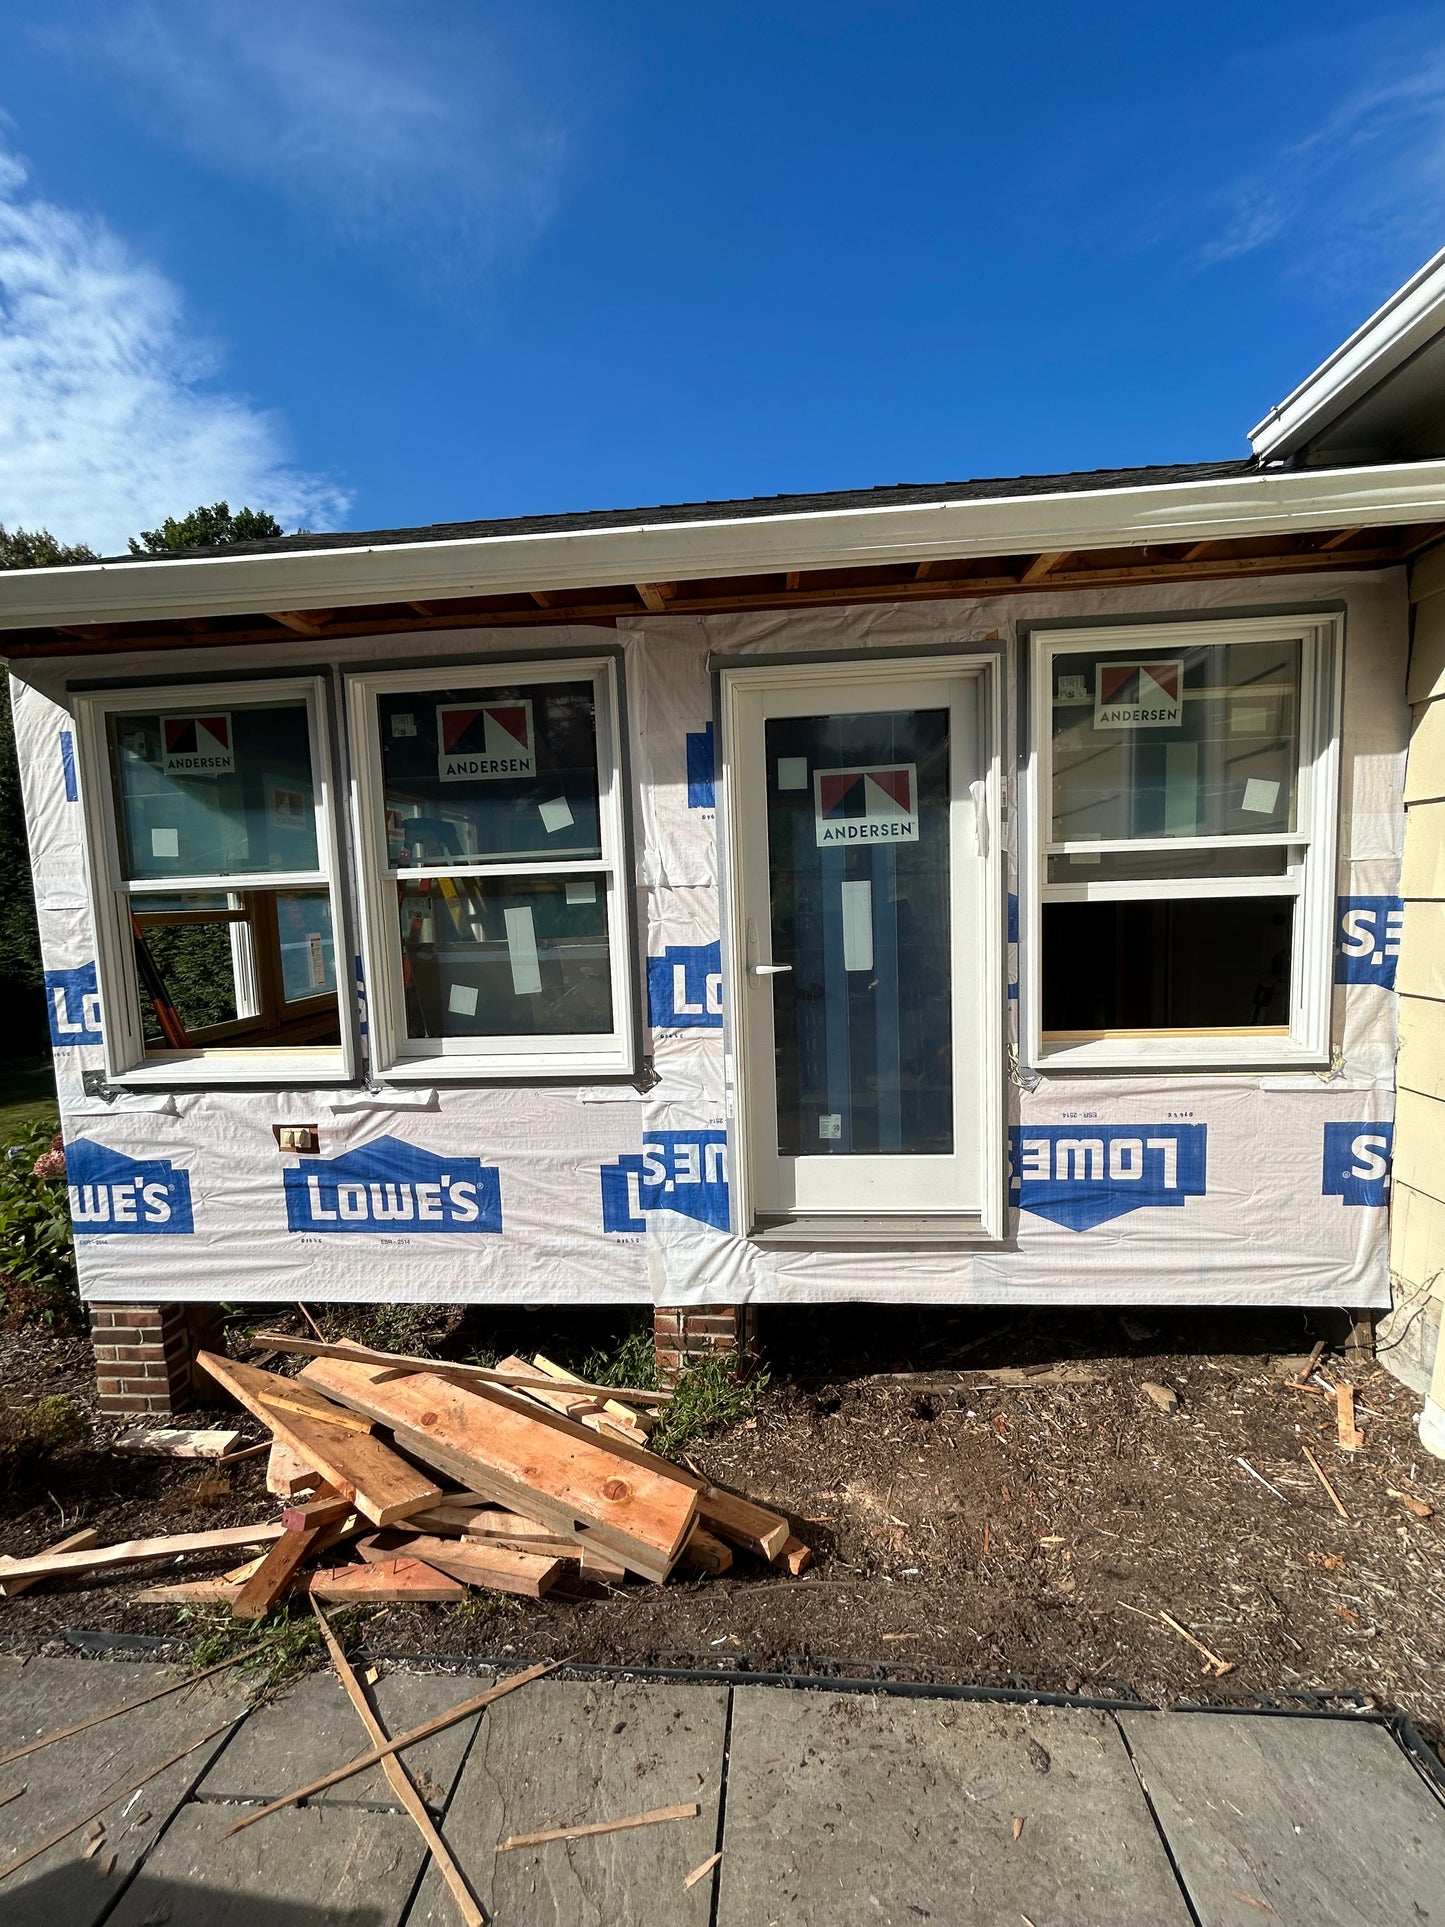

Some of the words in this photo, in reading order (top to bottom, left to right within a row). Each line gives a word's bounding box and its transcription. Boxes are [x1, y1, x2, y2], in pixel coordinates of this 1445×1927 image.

[1100, 709, 1177, 722] ANDERSEN
[168, 757, 231, 769] ANDERSEN
[446, 758, 530, 775] ANDERSEN
[823, 822, 912, 840] ANDERSEN
[307, 1175, 480, 1222] LOWE'S
